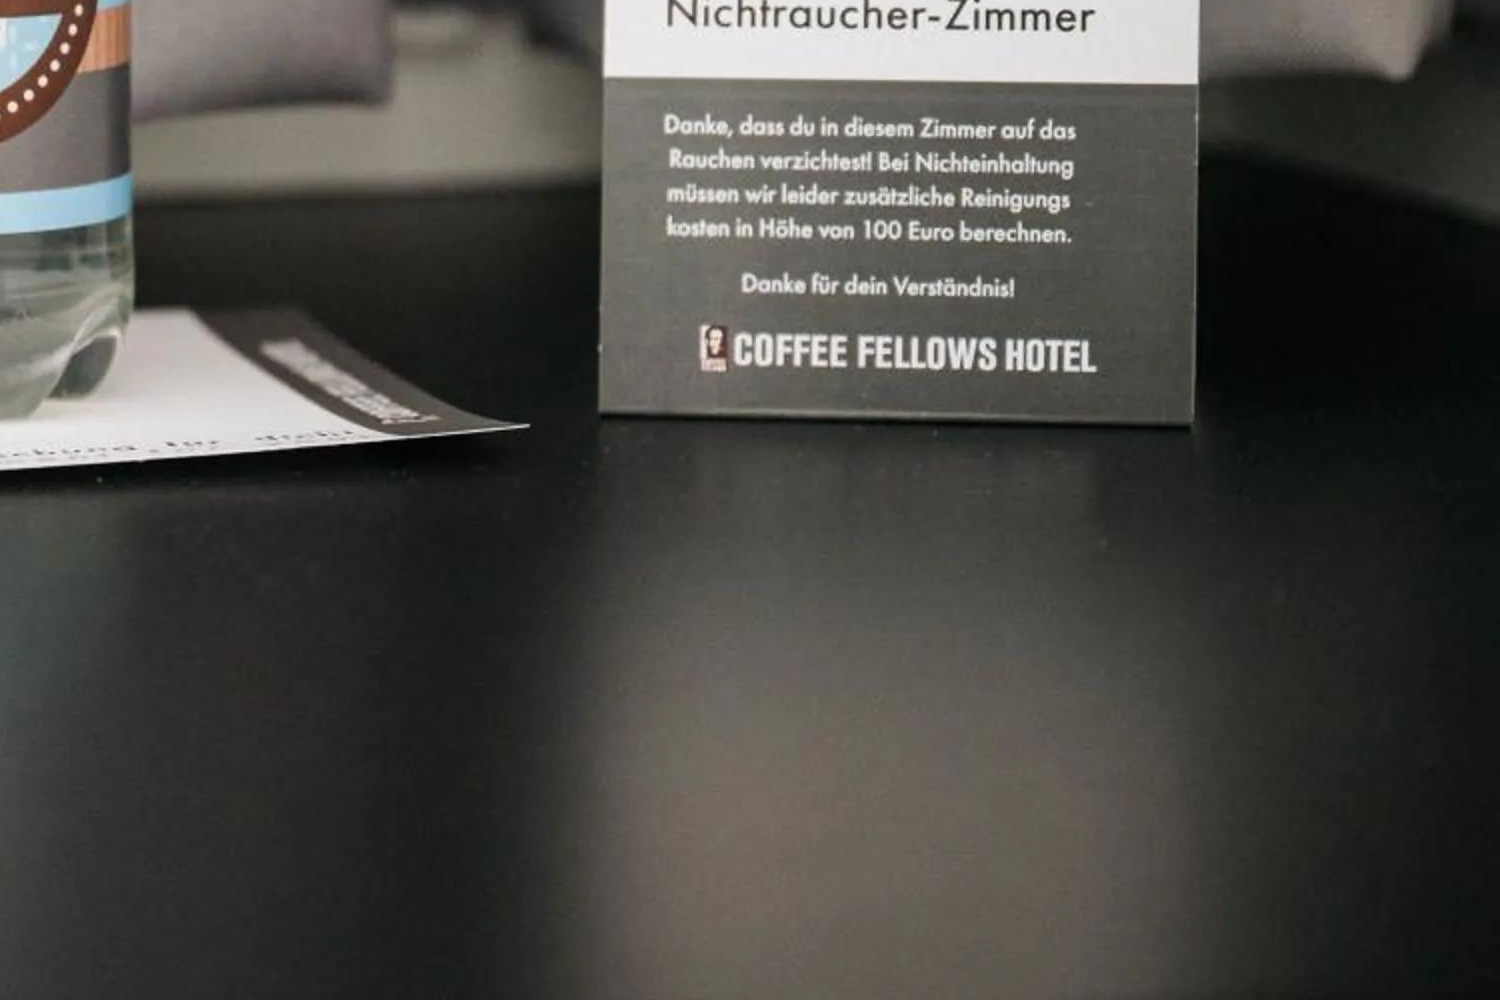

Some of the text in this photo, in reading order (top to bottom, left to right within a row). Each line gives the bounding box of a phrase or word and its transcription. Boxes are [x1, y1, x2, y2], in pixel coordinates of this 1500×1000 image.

[663, 113, 1077, 140] Danke, dass du in diesem Zimmer auf das
[669, 147, 1074, 180] Rauchen verzichtest! Bei Nichteinhaltung
[667, 183, 1071, 214] müssen wir leider zusätzliche Reinigungs
[667, 216, 1072, 244] kosten in Höhe von 100 Euro berechnen.
[741, 272, 1016, 298] Danke für dein Verständnis!
[733, 331, 1098, 373] COFFEE FELLOWS HOTEL
